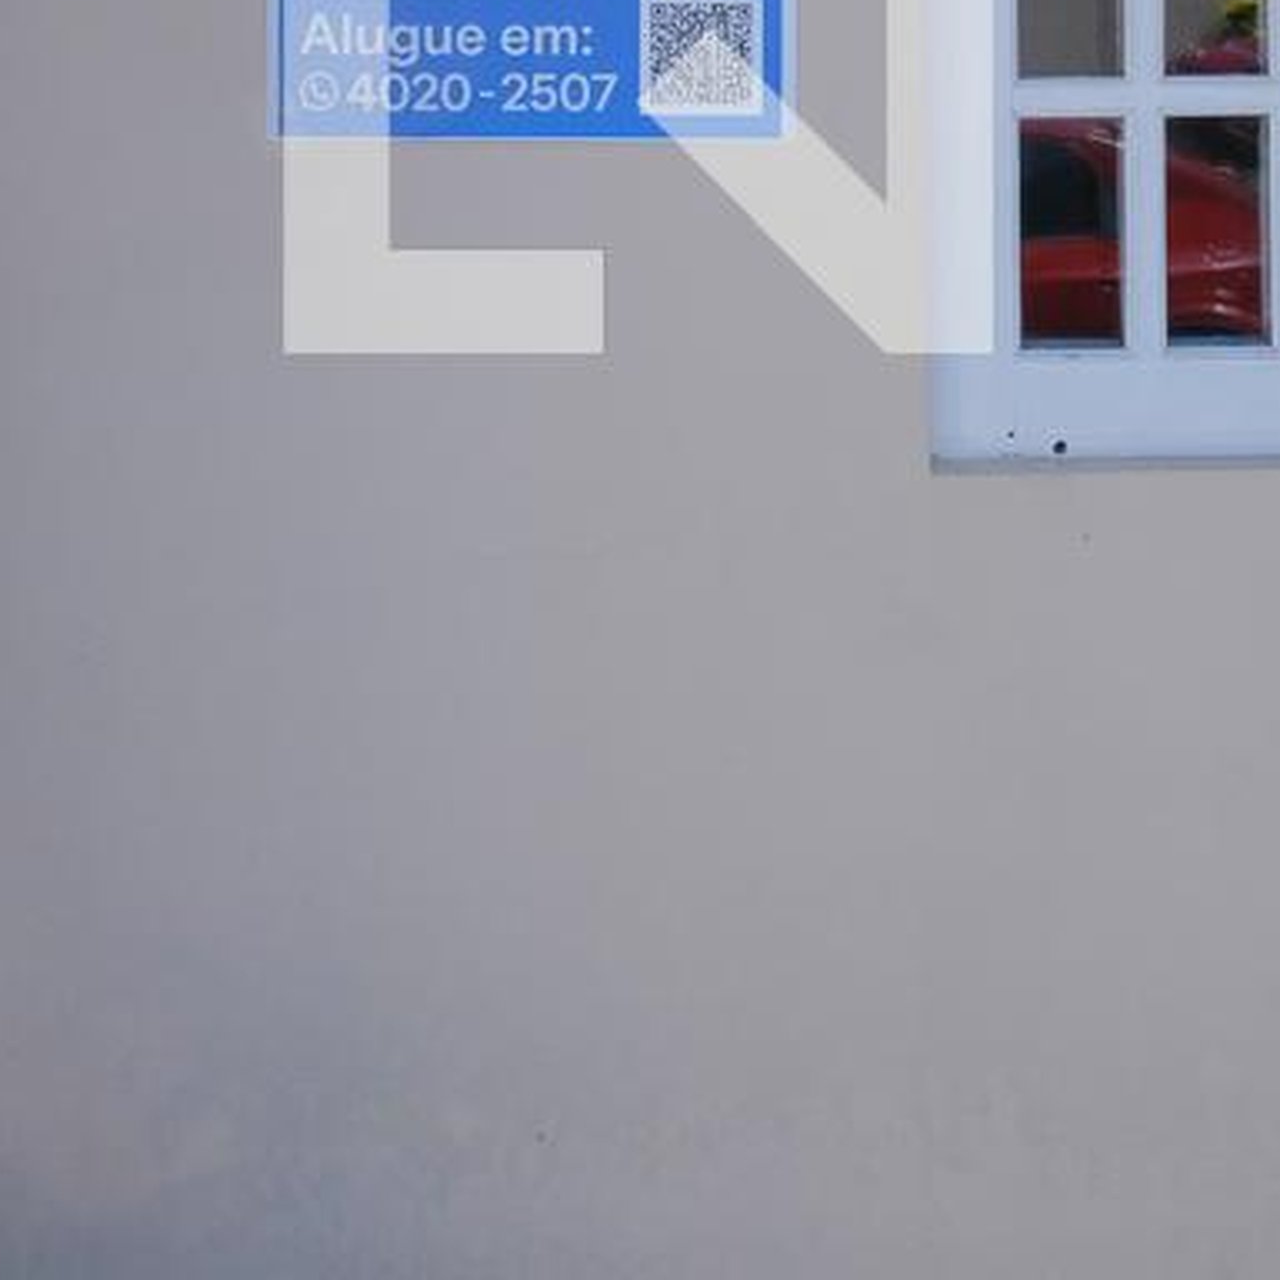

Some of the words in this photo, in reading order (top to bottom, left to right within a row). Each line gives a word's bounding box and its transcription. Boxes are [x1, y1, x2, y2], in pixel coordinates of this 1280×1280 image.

[299, 13, 487, 67] Alugue
[500, 22, 593, 57] em:
[346, 73, 619, 113] 4020-2507
